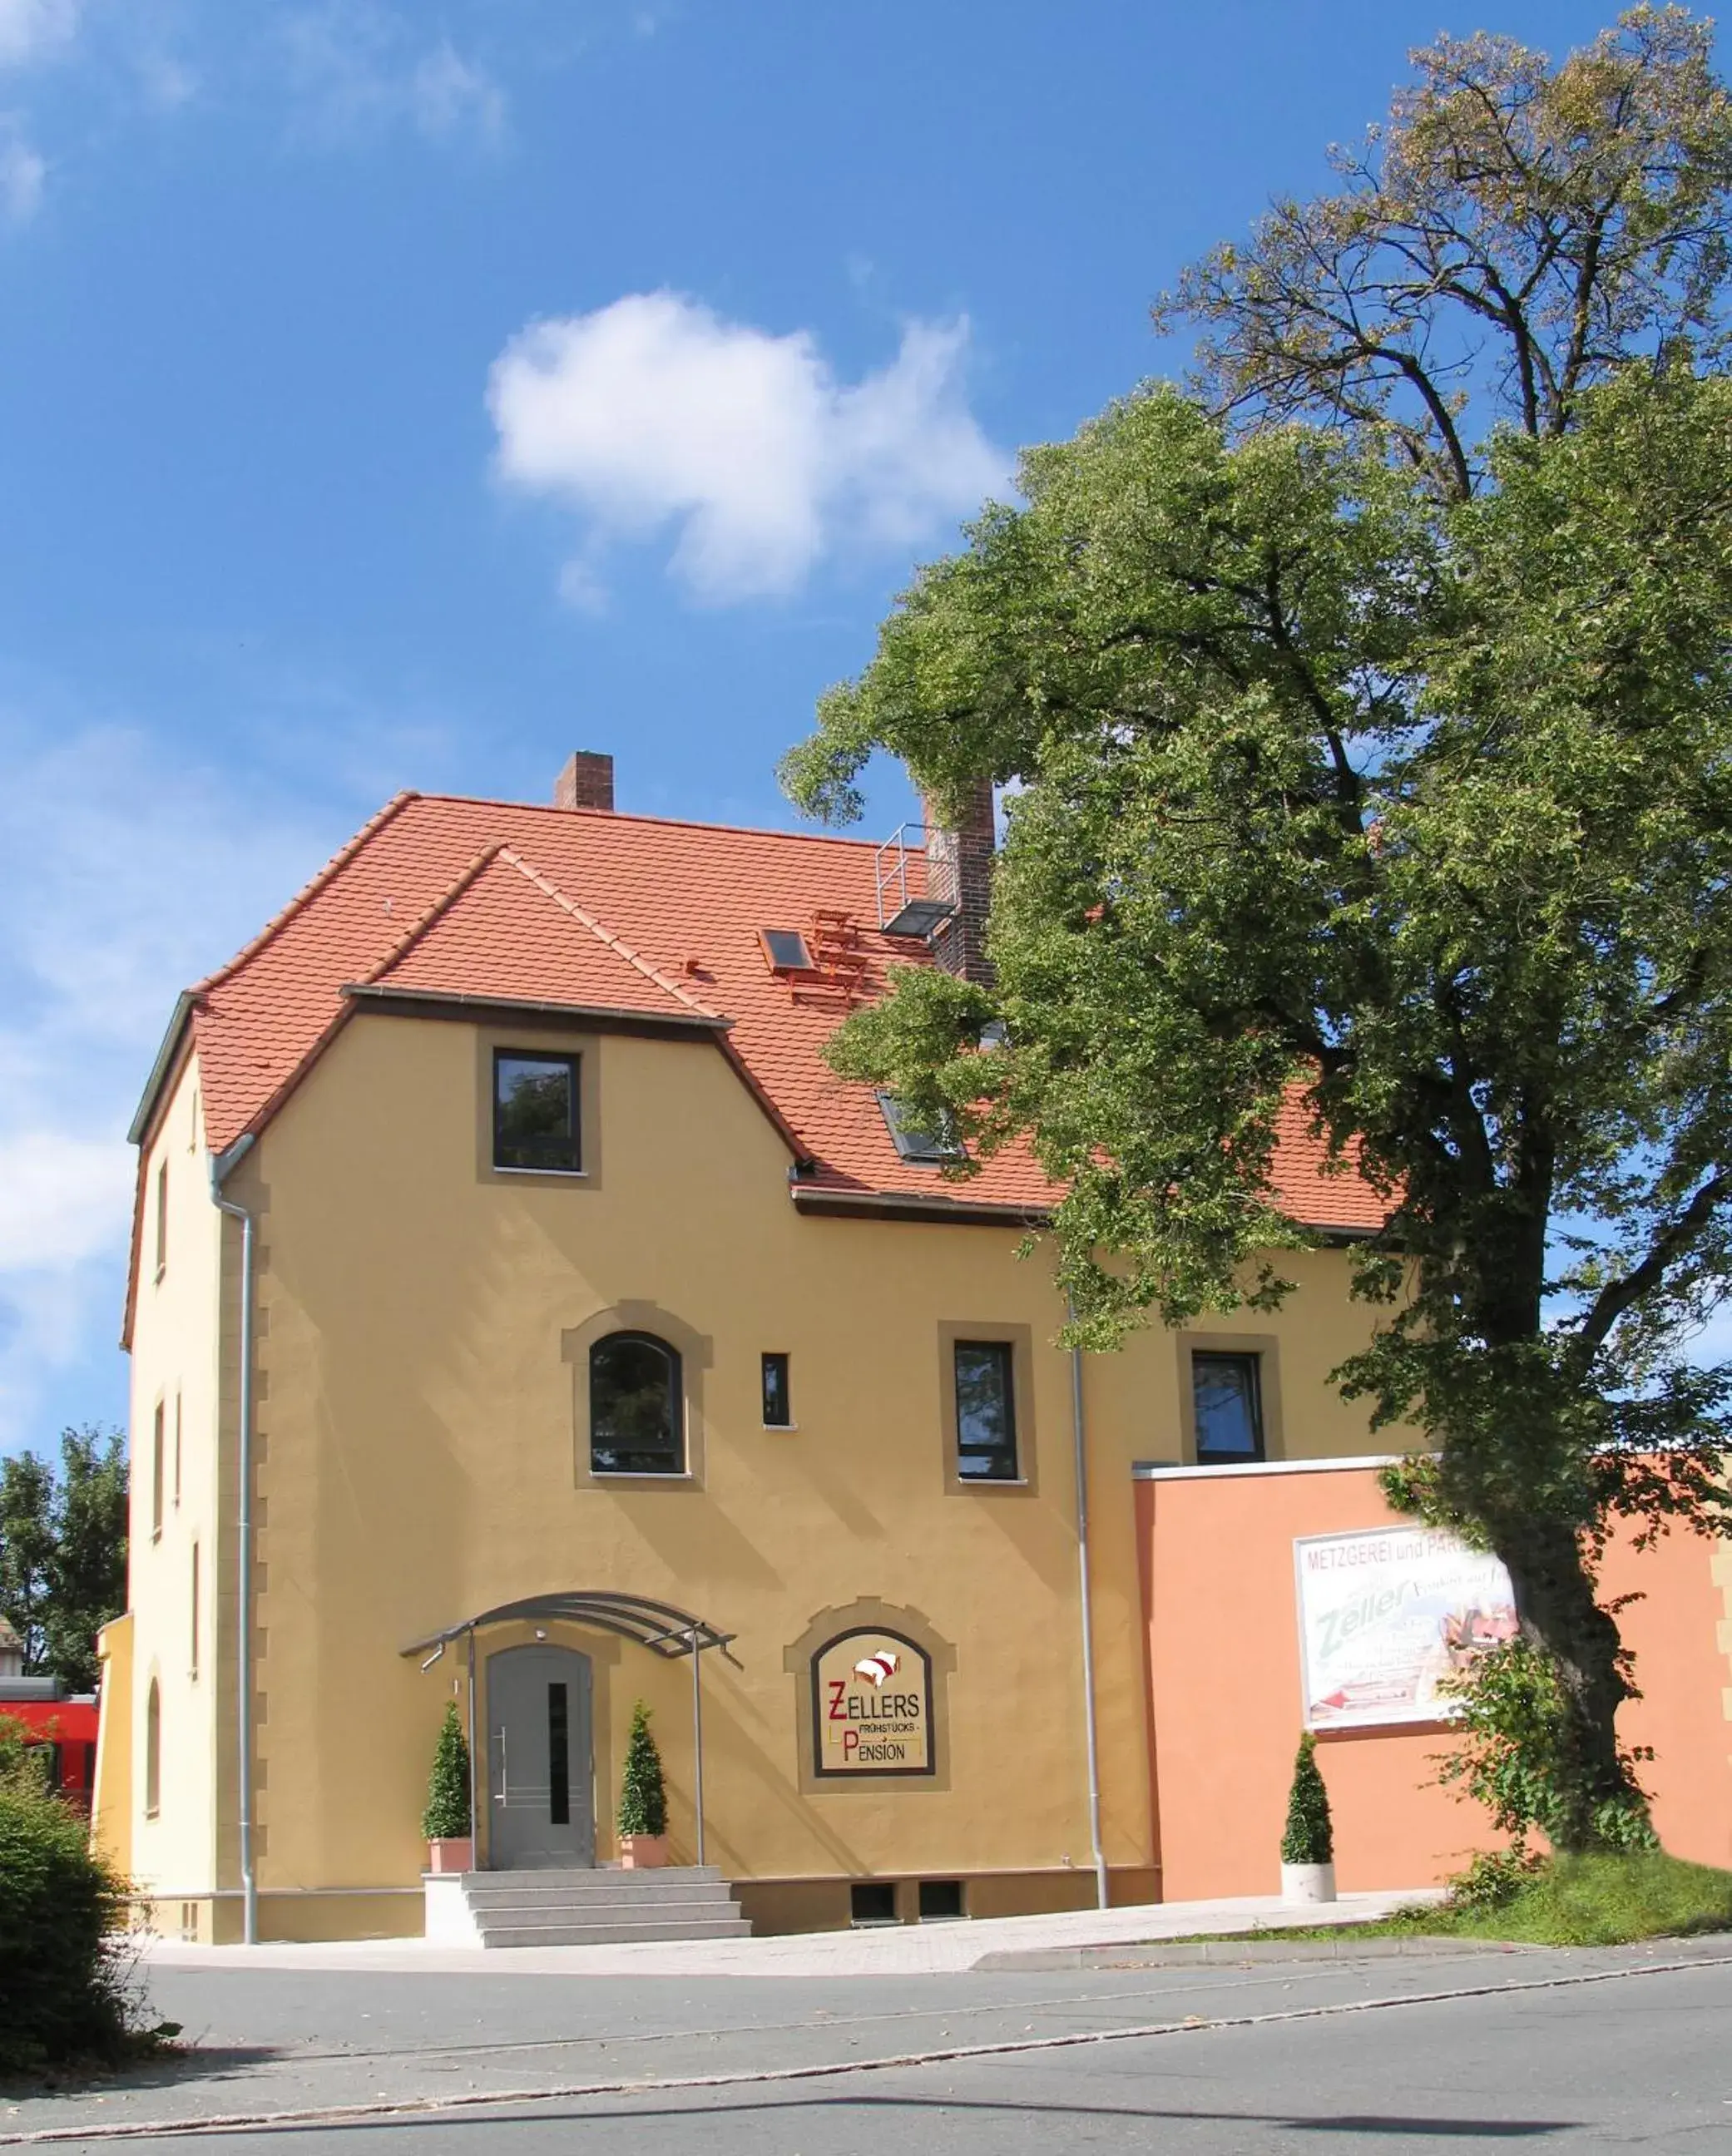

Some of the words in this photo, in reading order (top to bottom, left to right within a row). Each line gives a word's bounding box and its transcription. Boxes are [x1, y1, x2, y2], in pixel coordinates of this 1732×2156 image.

[1307, 1540, 1393, 1570] METZGEREI
[1396, 1540, 1423, 1561] und
[1316, 1580, 1411, 1659] Zeller
[829, 1680, 920, 1720] ZELLERS
[843, 1730, 905, 1762] PENSION
